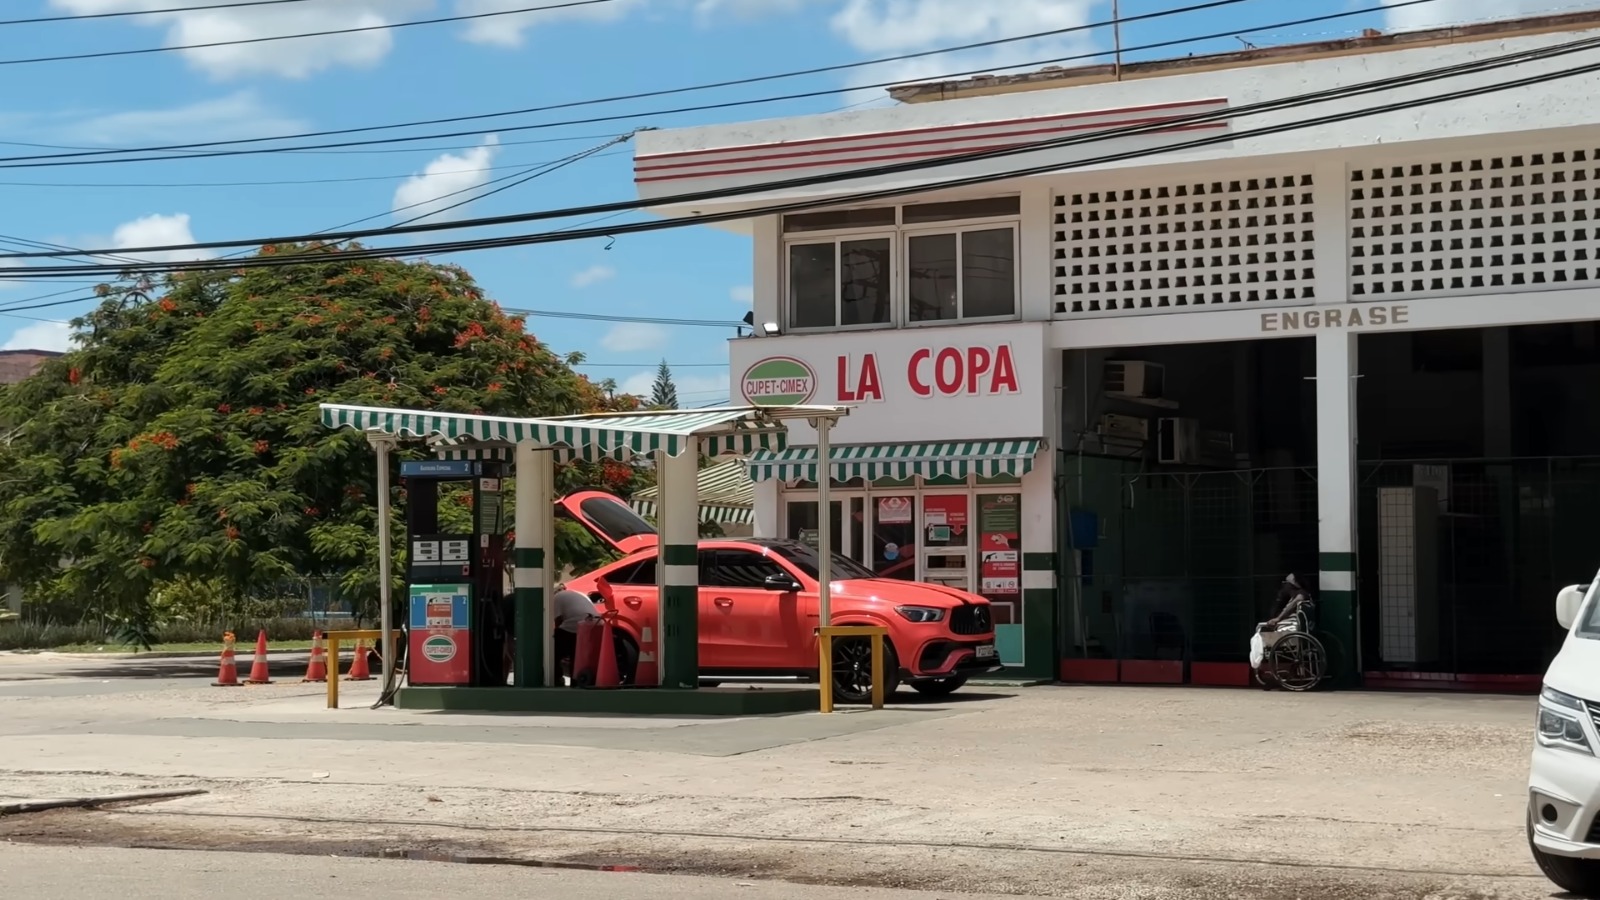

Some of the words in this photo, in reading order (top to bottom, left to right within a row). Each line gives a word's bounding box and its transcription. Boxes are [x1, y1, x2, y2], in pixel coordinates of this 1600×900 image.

[1261, 305, 1409, 332] ENGRASE
[837, 353, 882, 401] LA
[907, 344, 1018, 396] COPA
